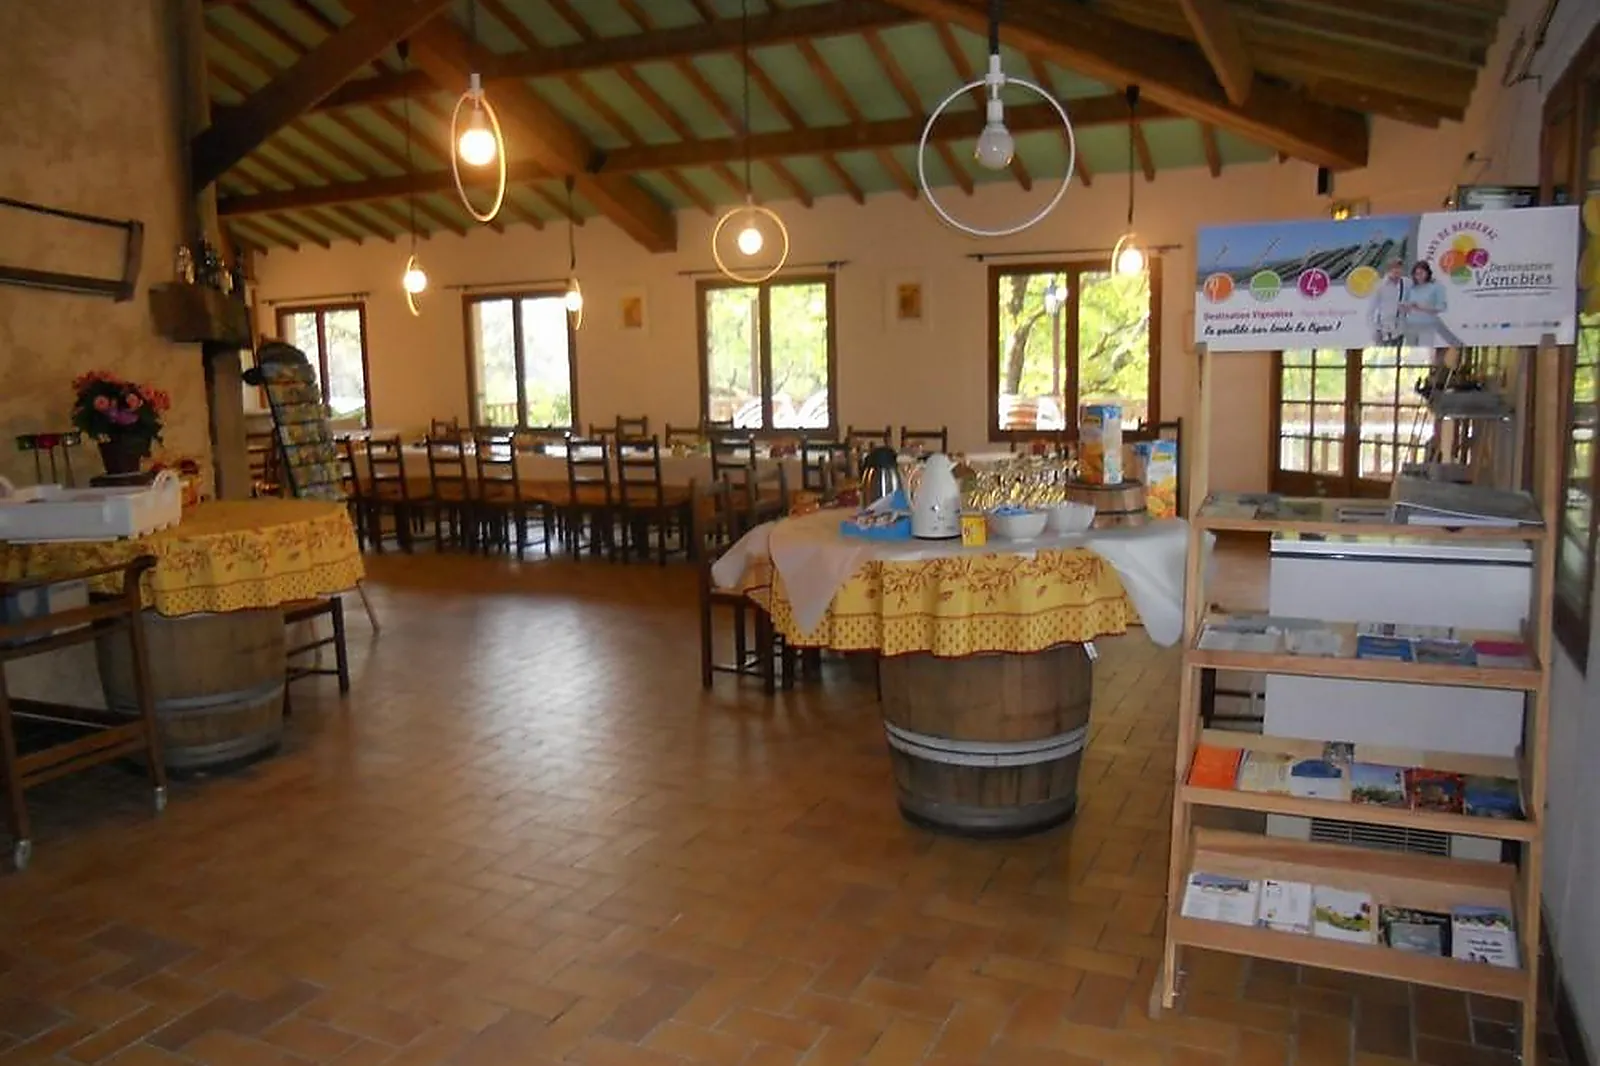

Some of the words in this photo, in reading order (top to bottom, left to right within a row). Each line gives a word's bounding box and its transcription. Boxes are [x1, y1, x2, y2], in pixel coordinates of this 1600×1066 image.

[1489, 263, 1554, 273] Destination
[1475, 270, 1553, 287] Vignobles
[1203, 311, 1250, 321] Destination
[1252, 309, 1294, 319] Vignobles
